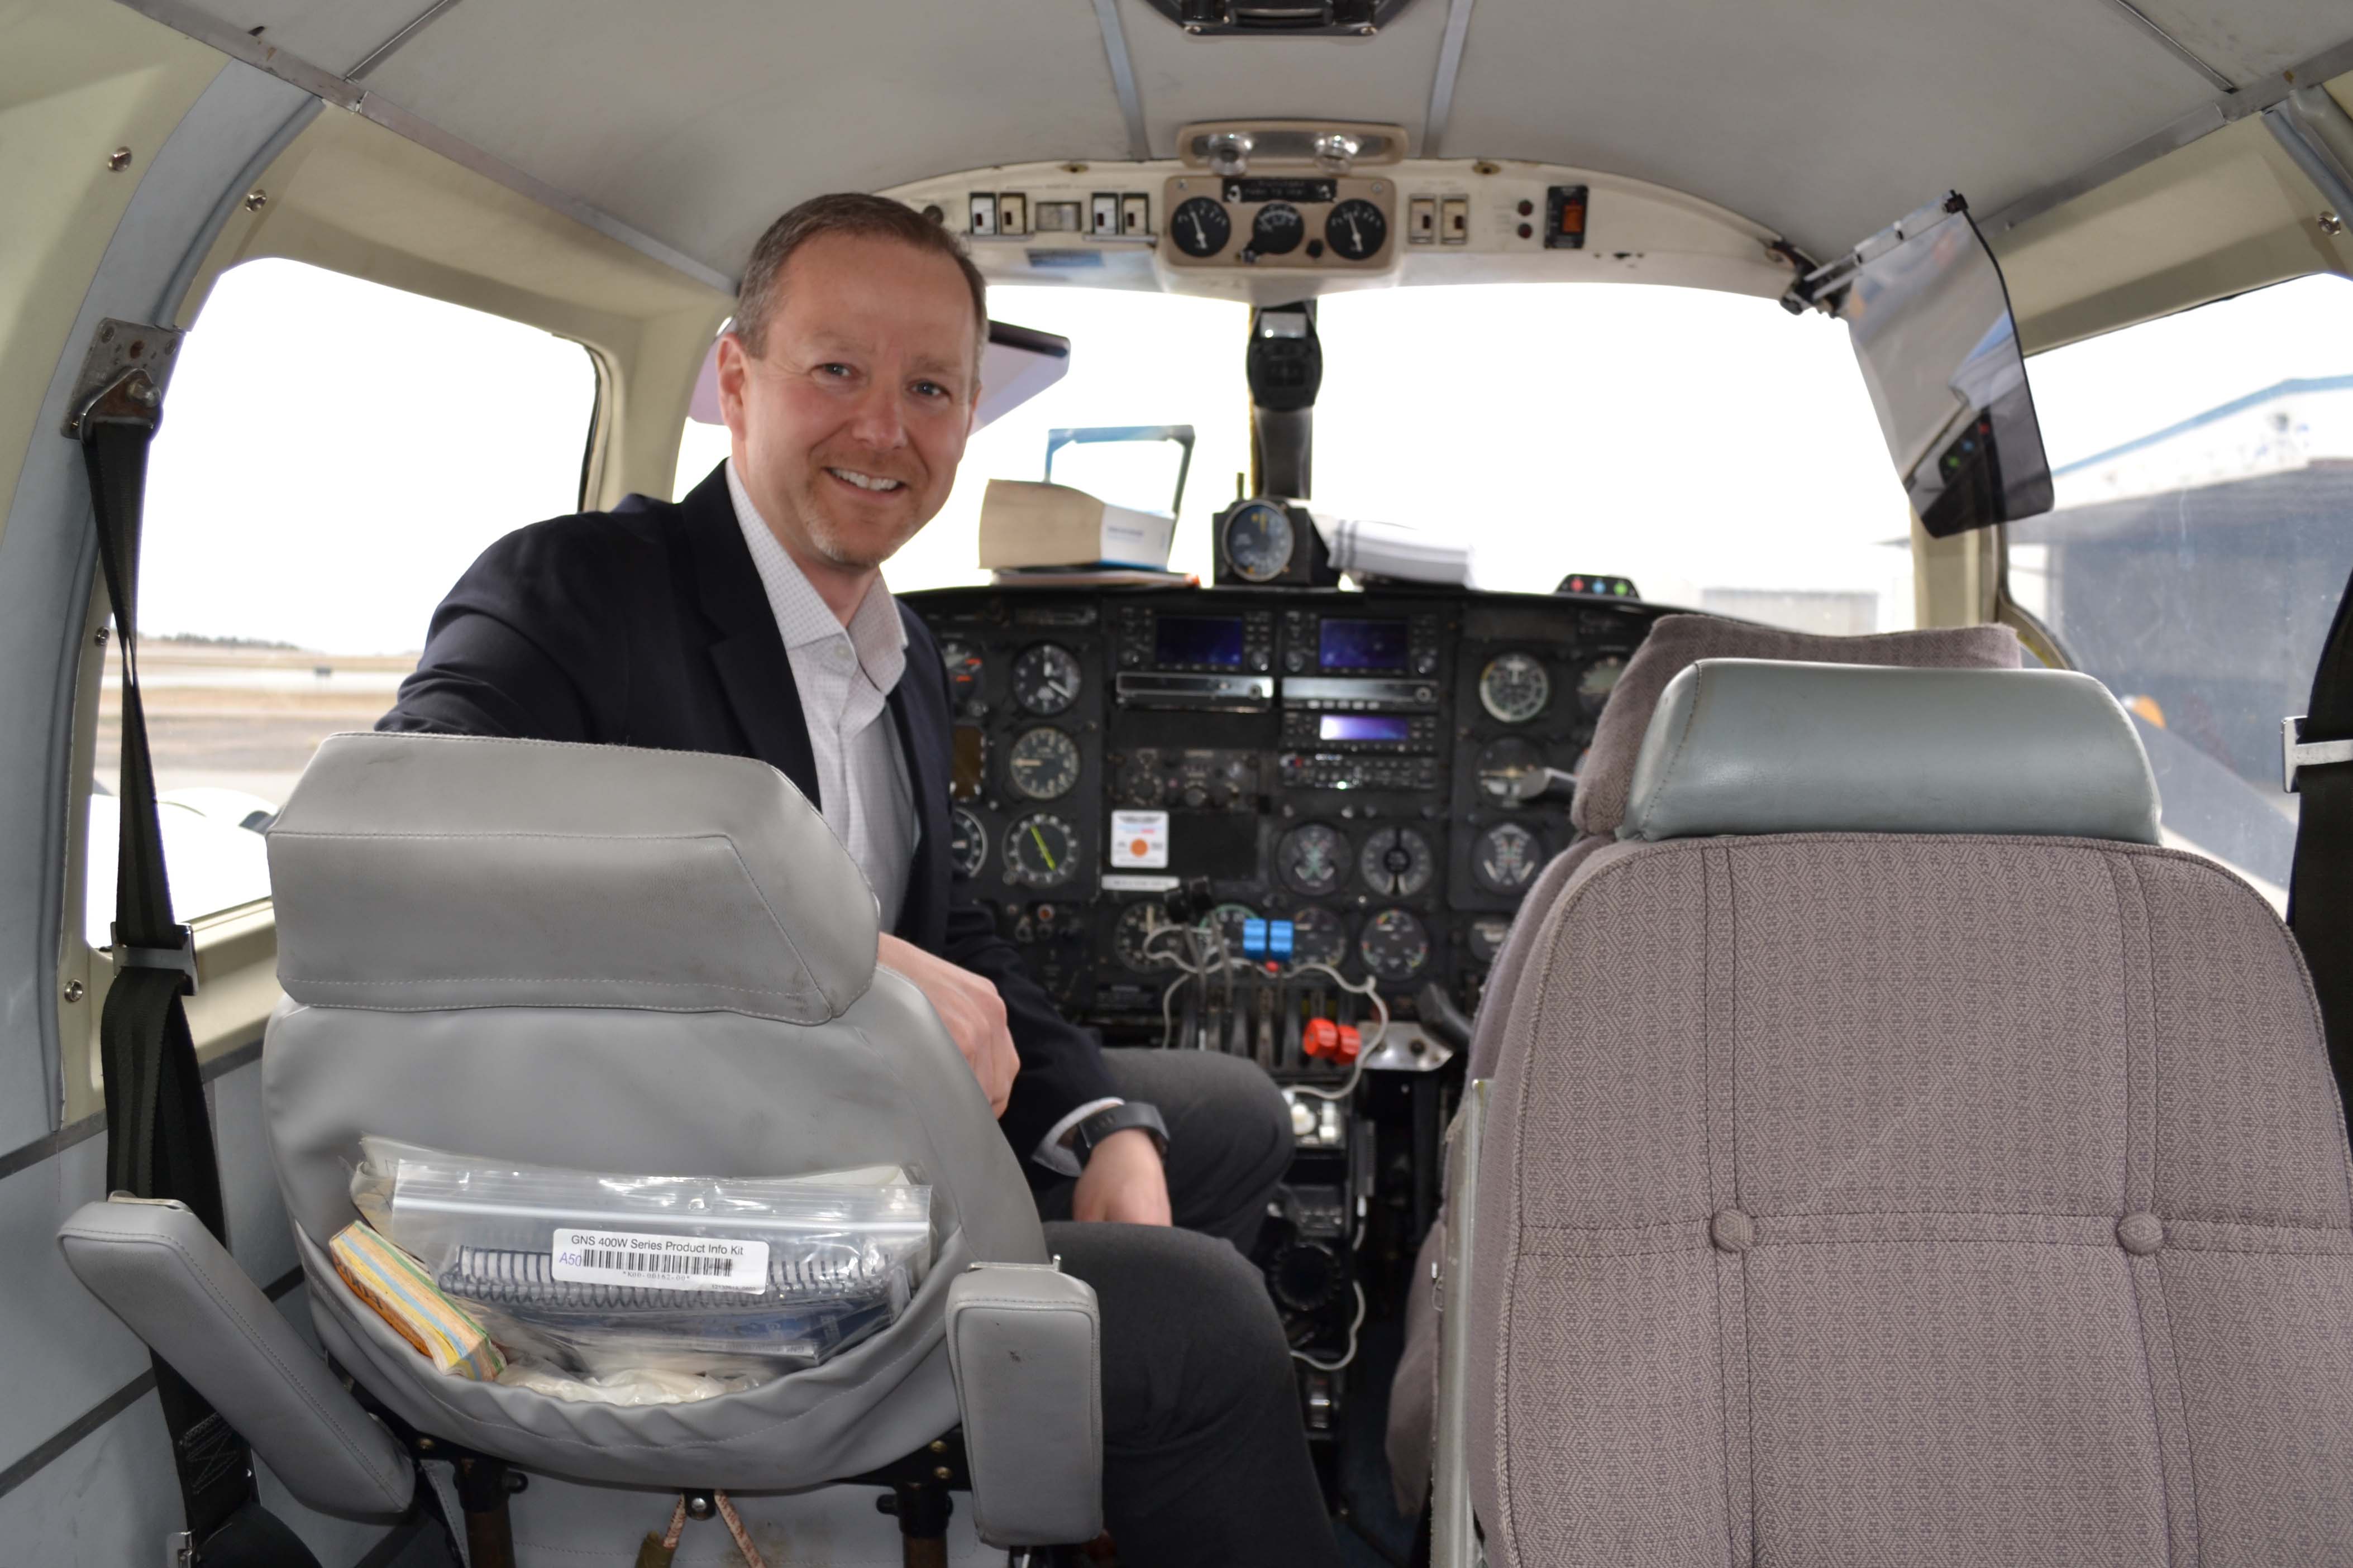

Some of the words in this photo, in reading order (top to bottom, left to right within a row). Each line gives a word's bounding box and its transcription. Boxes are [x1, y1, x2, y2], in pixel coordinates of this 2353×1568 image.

[571, 1235, 595, 1245] GNS
[598, 1237, 628, 1248] 400W
[631, 1239, 662, 1250] Series
[665, 1241, 705, 1253] Product
[708, 1244, 728, 1254] Info
[731, 1245, 744, 1255] Kit
[559, 1252, 582, 1266] A50
